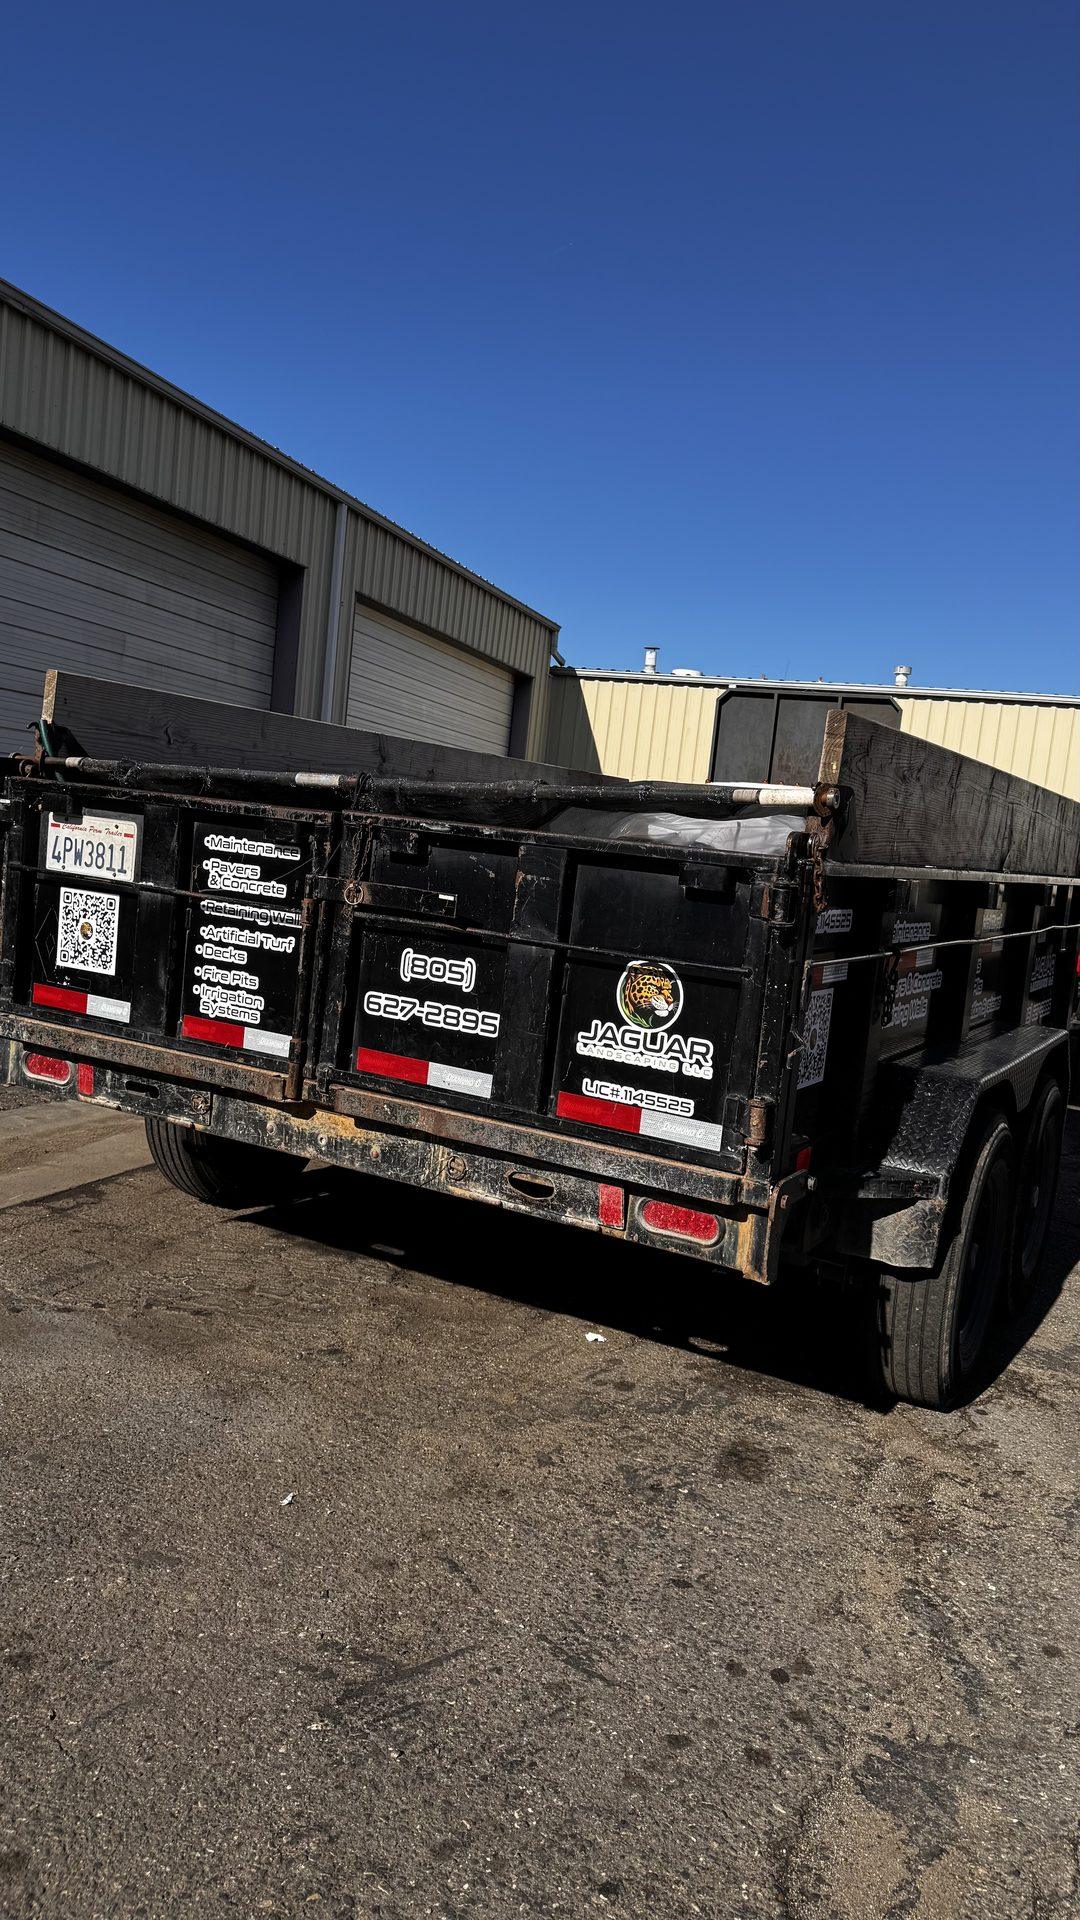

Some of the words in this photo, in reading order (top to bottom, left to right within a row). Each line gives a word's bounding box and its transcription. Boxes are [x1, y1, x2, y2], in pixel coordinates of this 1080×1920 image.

[51, 835, 127, 874] 4PW3811
[210, 836, 301, 860] Maintenance
[210, 859, 260, 878] Pavers
[208, 873, 222, 888] &
[221, 877, 287, 898] Concrete
[206, 901, 271, 926] Retaining
[272, 910, 303, 929] Wall
[205, 926, 260, 947] Artificial
[261, 933, 296, 953] Turf
[203, 945, 247, 964] Decks
[202, 966, 231, 985] Fire
[231, 970, 259, 989] Pits
[400, 948, 476, 992] (805)
[200, 985, 265, 1010] Irrigation
[200, 1001, 261, 1024] Systems
[364, 991, 500, 1038] 627-2895
[577, 1019, 713, 1067] JAGUAR
[576, 1043, 680, 1072] LANDSCAPING
[682, 1063, 713, 1080] LLC
